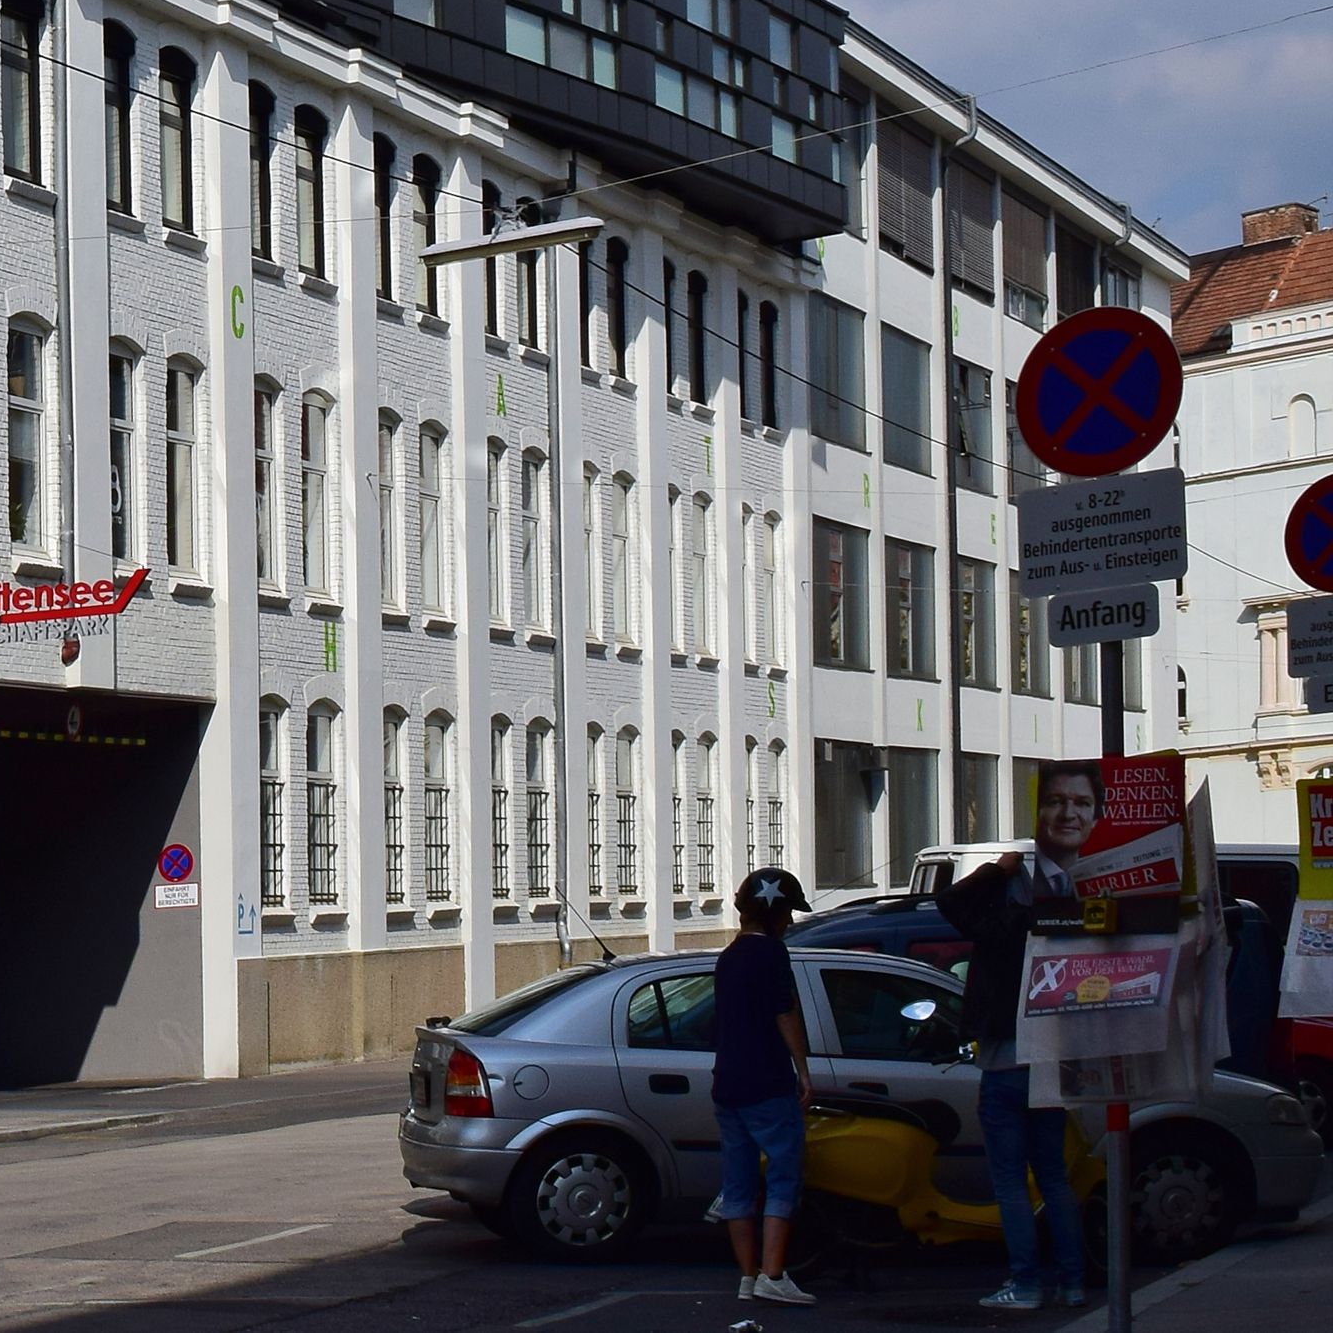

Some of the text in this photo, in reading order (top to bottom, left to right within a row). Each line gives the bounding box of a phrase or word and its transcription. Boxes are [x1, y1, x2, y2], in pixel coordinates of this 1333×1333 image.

[1051, 507, 1151, 533] ausgenommen
[1023, 525, 1182, 559] Behindertentransporte
[1027, 565, 1056, 580] zum
[1059, 560, 1090, 576] Aus-
[1105, 549, 1178, 569] Einsteigen
[1060, 600, 1146, 632] Anfang
[1113, 768, 1170, 784] LESEN.
[1104, 785, 1178, 802] DENKEN.
[1102, 803, 1180, 820] WÄHLEN.
[1085, 867, 1158, 894] KURIER
